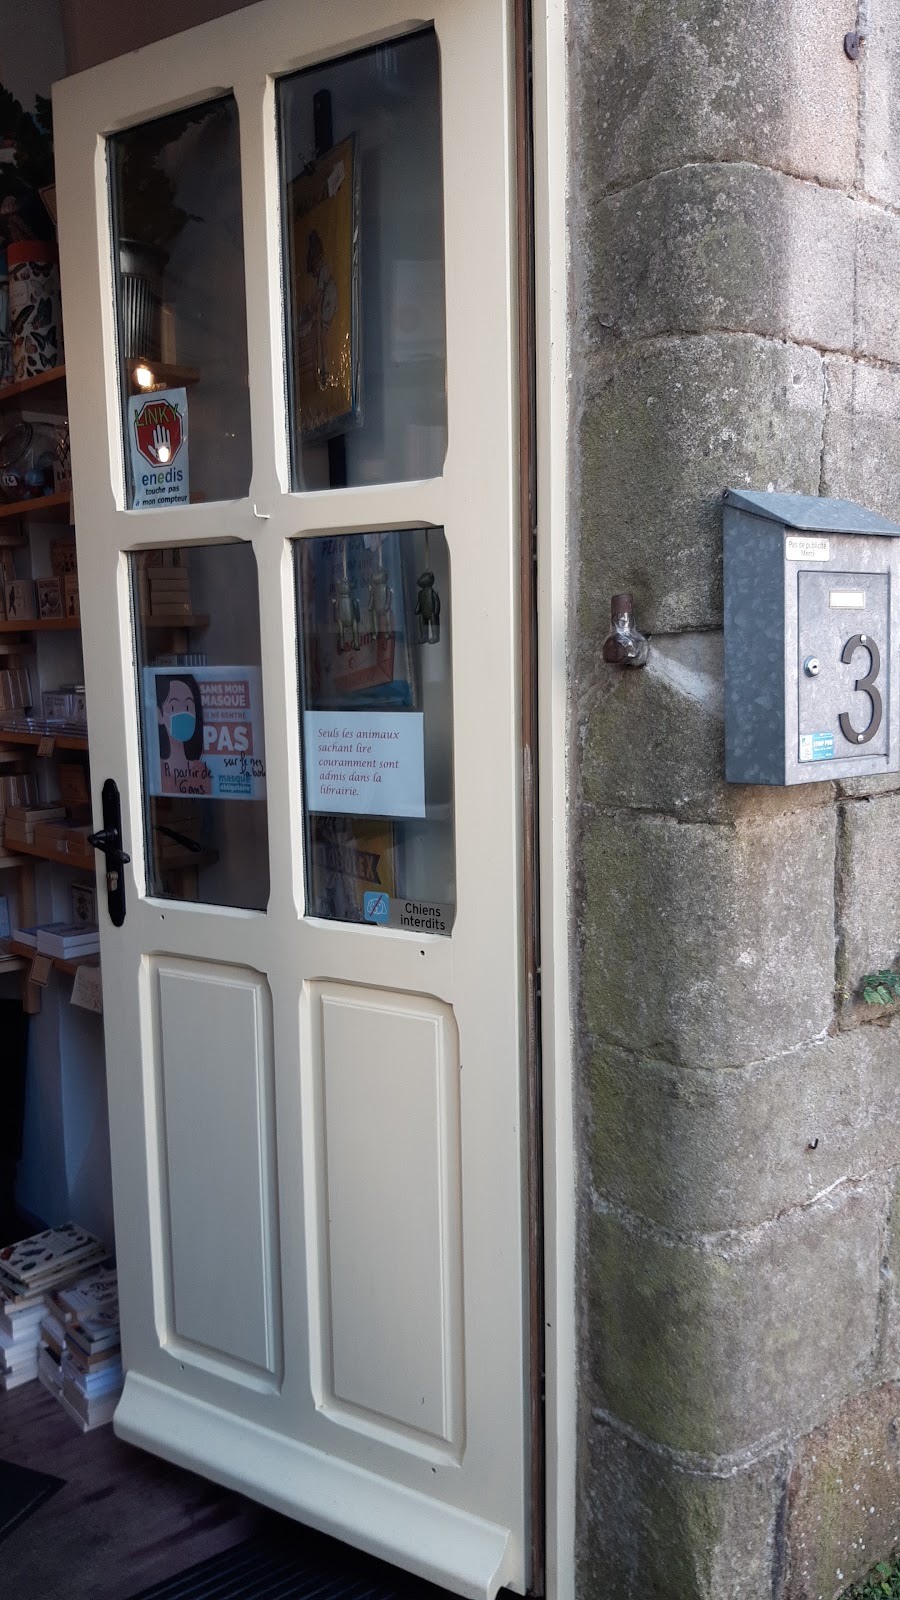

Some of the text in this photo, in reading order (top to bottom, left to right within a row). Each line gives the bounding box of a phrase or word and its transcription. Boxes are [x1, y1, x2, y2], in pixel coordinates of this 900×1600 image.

[134, 403, 179, 427] LINKY
[141, 467, 183, 486] enedis
[145, 485, 180, 495] touche pas
[157, 495, 188, 504] compteur
[788, 540, 798, 548] Pas
[805, 541, 827, 550] publicité
[200, 684, 245, 694] SANS MON
[838, 633, 883, 745] 3
[201, 695, 246, 707] MASQUE
[203, 725, 249, 752] PAS
[317, 728, 399, 740] Seuls les animaux
[318, 743, 372, 754] sachant lire
[223, 757, 238, 768] sur
[318, 758, 399, 769] couramment sont
[173, 761, 199, 786] partir
[201, 761, 214, 779] de
[319, 771, 382, 783] admis dans la
[219, 774, 252, 785] masque
[188, 784, 206, 795] ans
[320, 785, 359, 796] librairie.
[404, 902, 442, 917] Chiens
[400, 915, 446, 931] interdits
